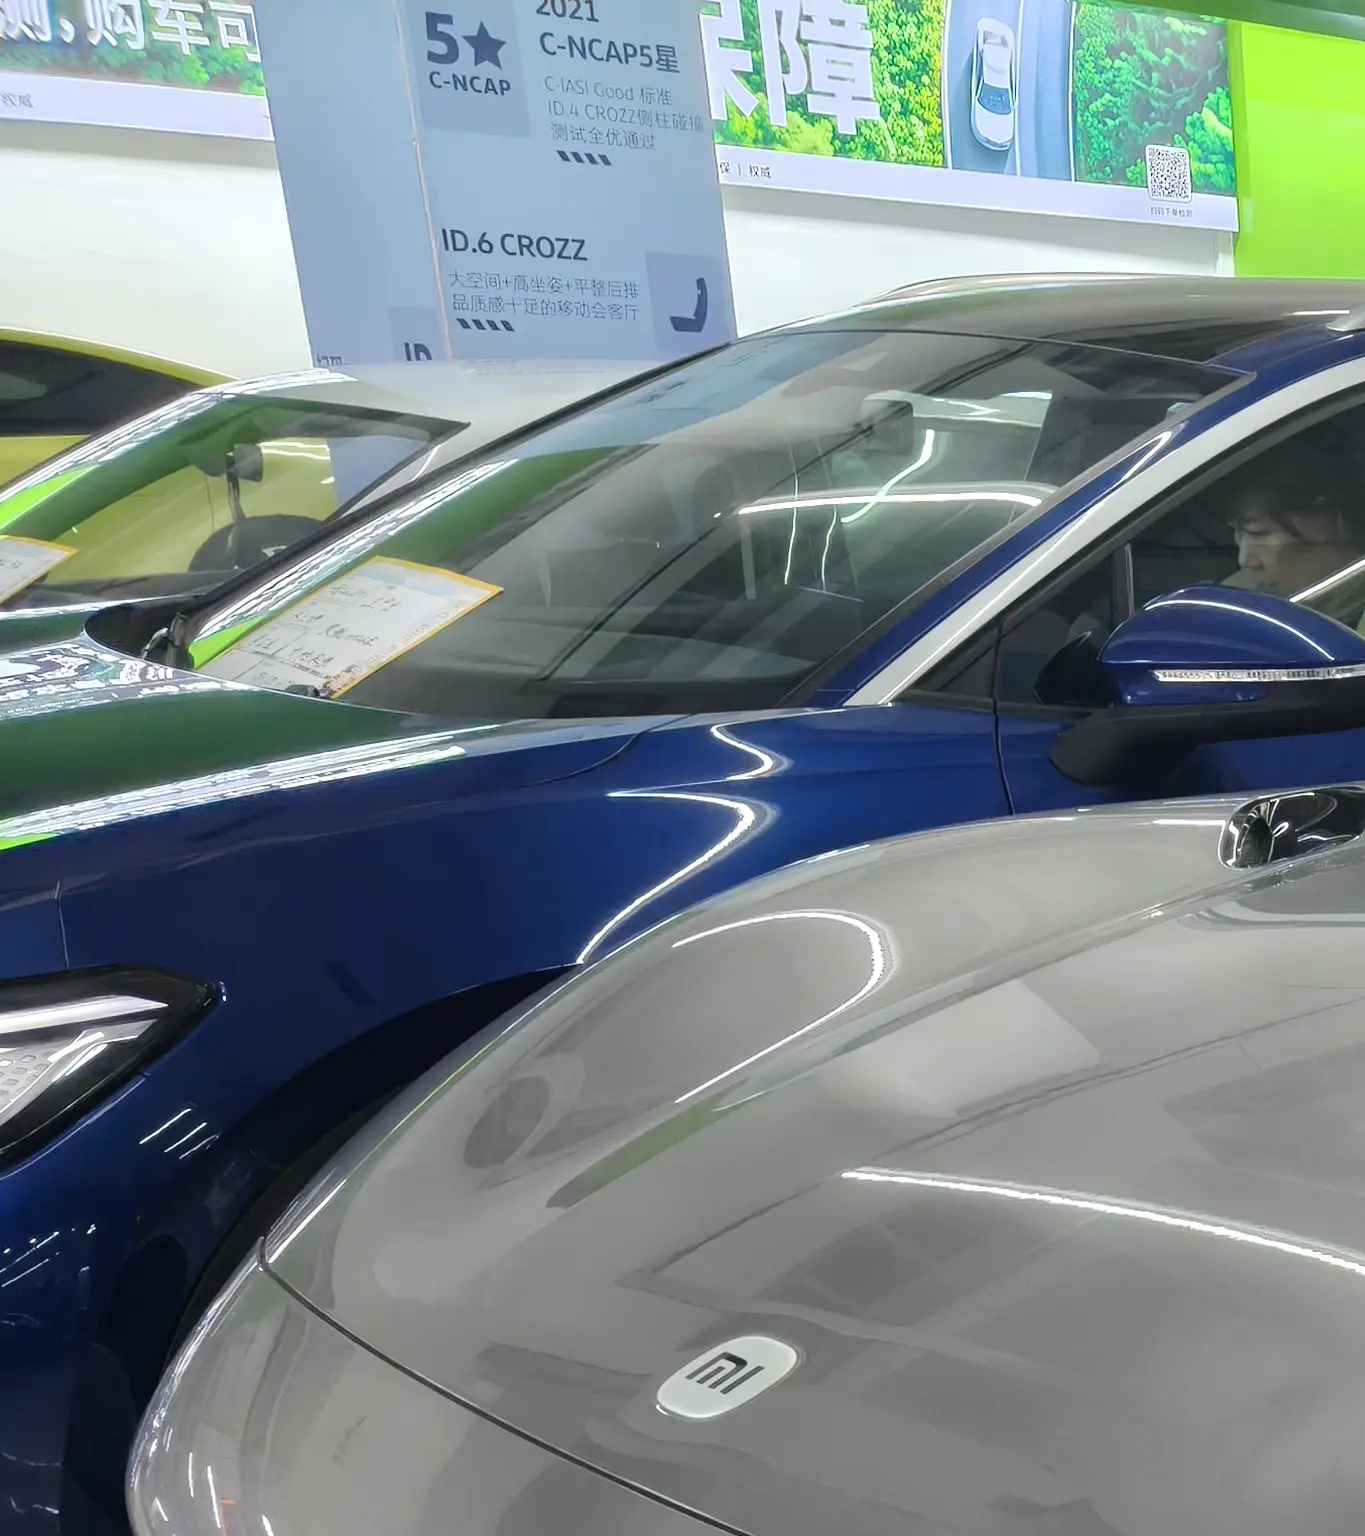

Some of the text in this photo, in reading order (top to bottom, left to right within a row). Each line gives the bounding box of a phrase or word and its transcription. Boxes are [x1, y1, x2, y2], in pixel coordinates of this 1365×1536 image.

[536, 0, 600, 22] 2021
[425, 11, 460, 65] 5
[540, 32, 680, 74] C-NCAP5星
[429, 71, 511, 96] C-NCAP
[594, 81, 634, 101] Good
[639, 86, 673, 105] 标准
[548, 100, 579, 117] ID.4
[551, 122, 657, 150] 测试全优通过
[441, 227, 588, 262] ID.6 CROZZ
[452, 293, 641, 322] 品质感十足的移动会客厅
